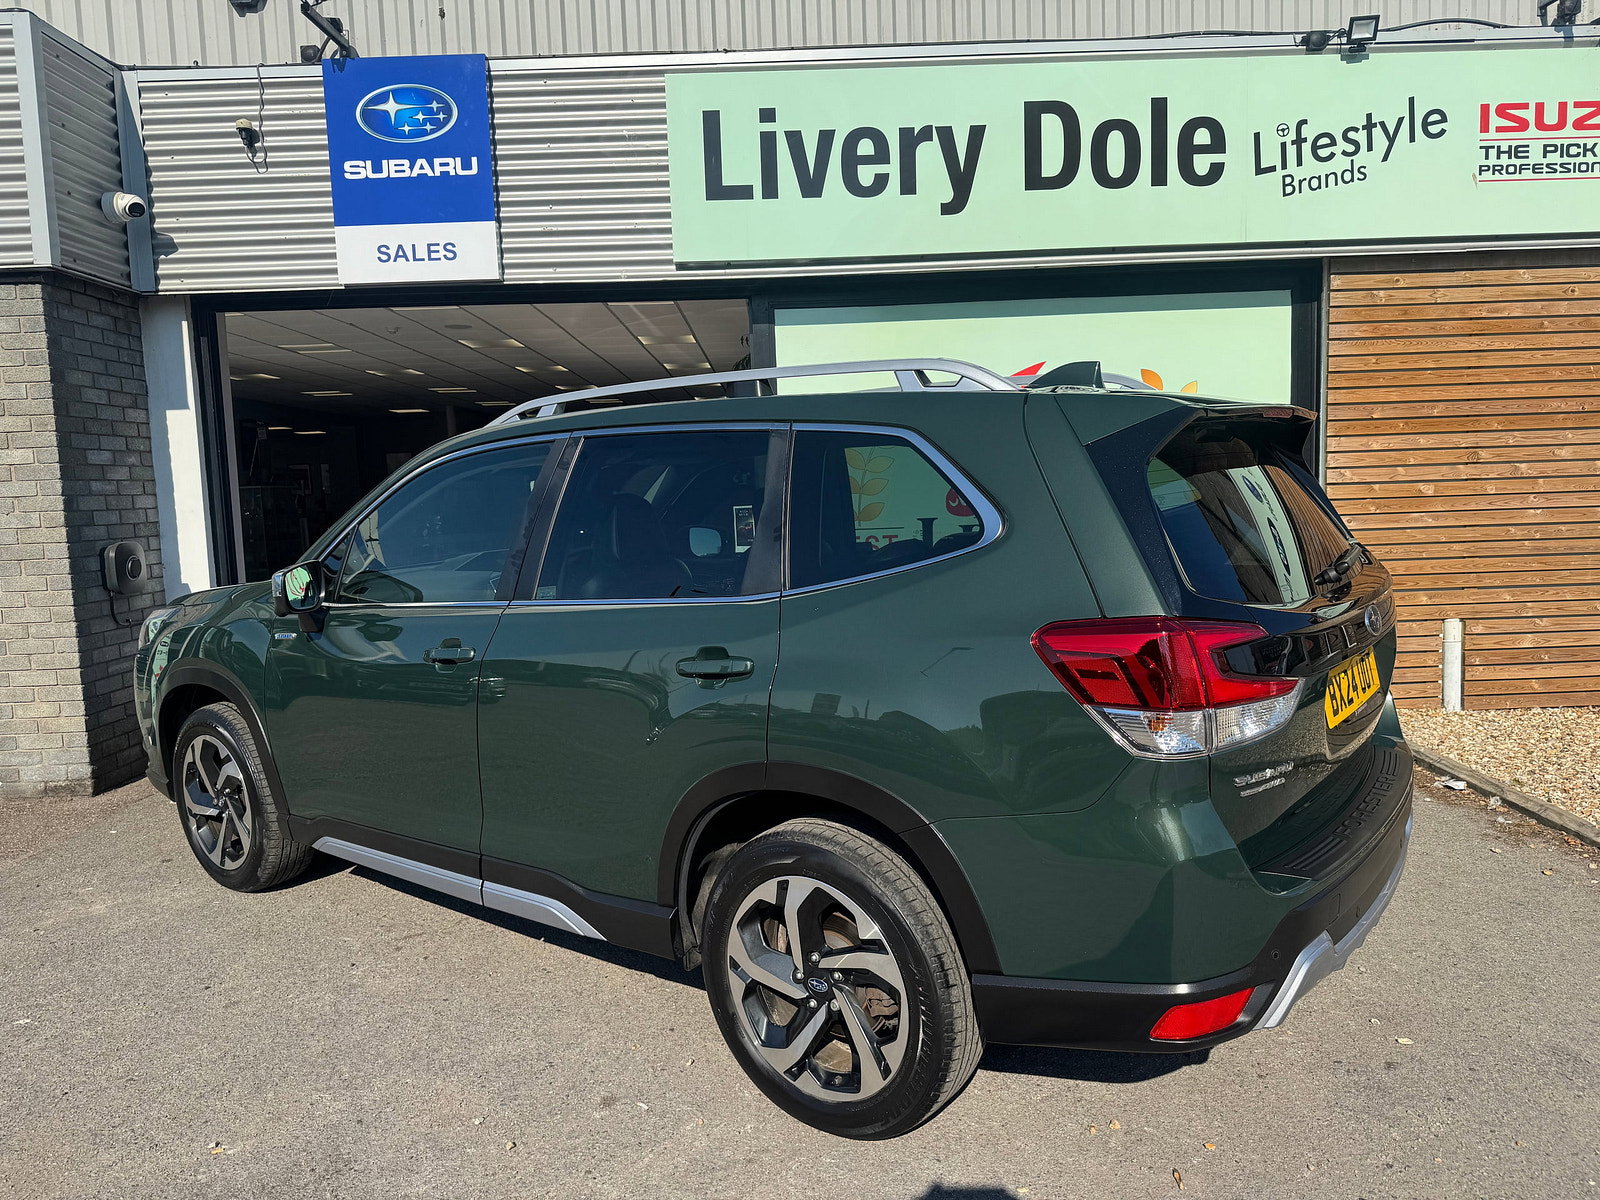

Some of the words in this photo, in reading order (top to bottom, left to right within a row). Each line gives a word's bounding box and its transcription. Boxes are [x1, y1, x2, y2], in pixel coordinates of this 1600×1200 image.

[701, 107, 988, 216] Livery
[1023, 96, 1227, 192] Dole
[1252, 96, 1449, 177] Lifestyle
[1478, 144, 1530, 161] THE
[1542, 142, 1599, 159] PICK
[343, 156, 479, 180] SUBARU
[1281, 158, 1368, 198] Brands
[376, 241, 458, 264] SALES
[1331, 774, 1396, 839] FORESTER
